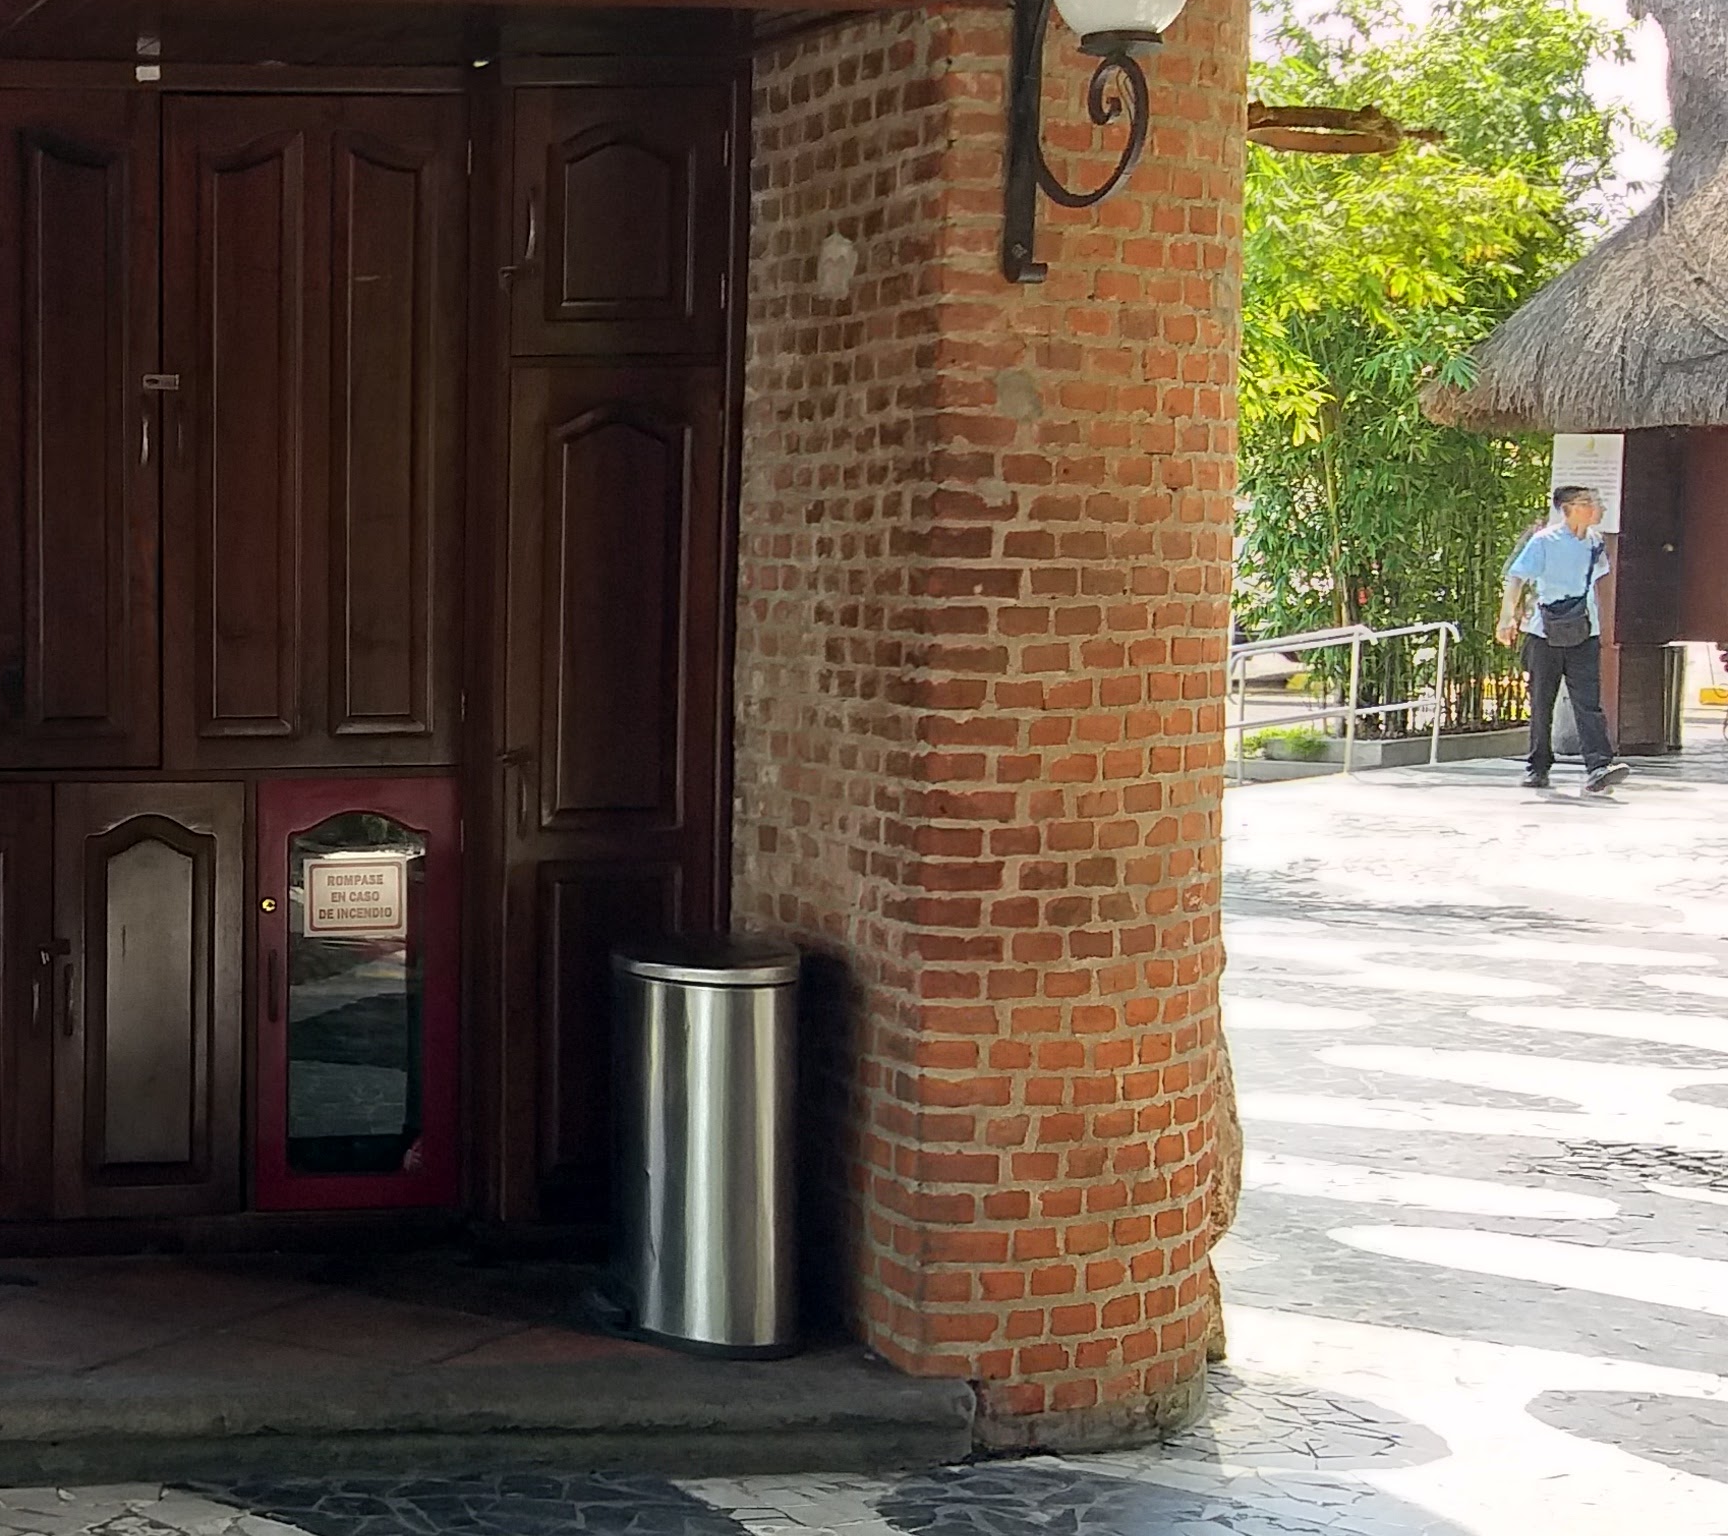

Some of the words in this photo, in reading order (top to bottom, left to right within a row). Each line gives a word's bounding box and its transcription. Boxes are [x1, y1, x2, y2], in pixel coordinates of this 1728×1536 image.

[327, 874, 384, 886] ROMPASE
[330, 891, 346, 903] EN
[349, 891, 380, 902] CASO
[318, 908, 334, 920] DE
[337, 907, 392, 920] INCENDIO
